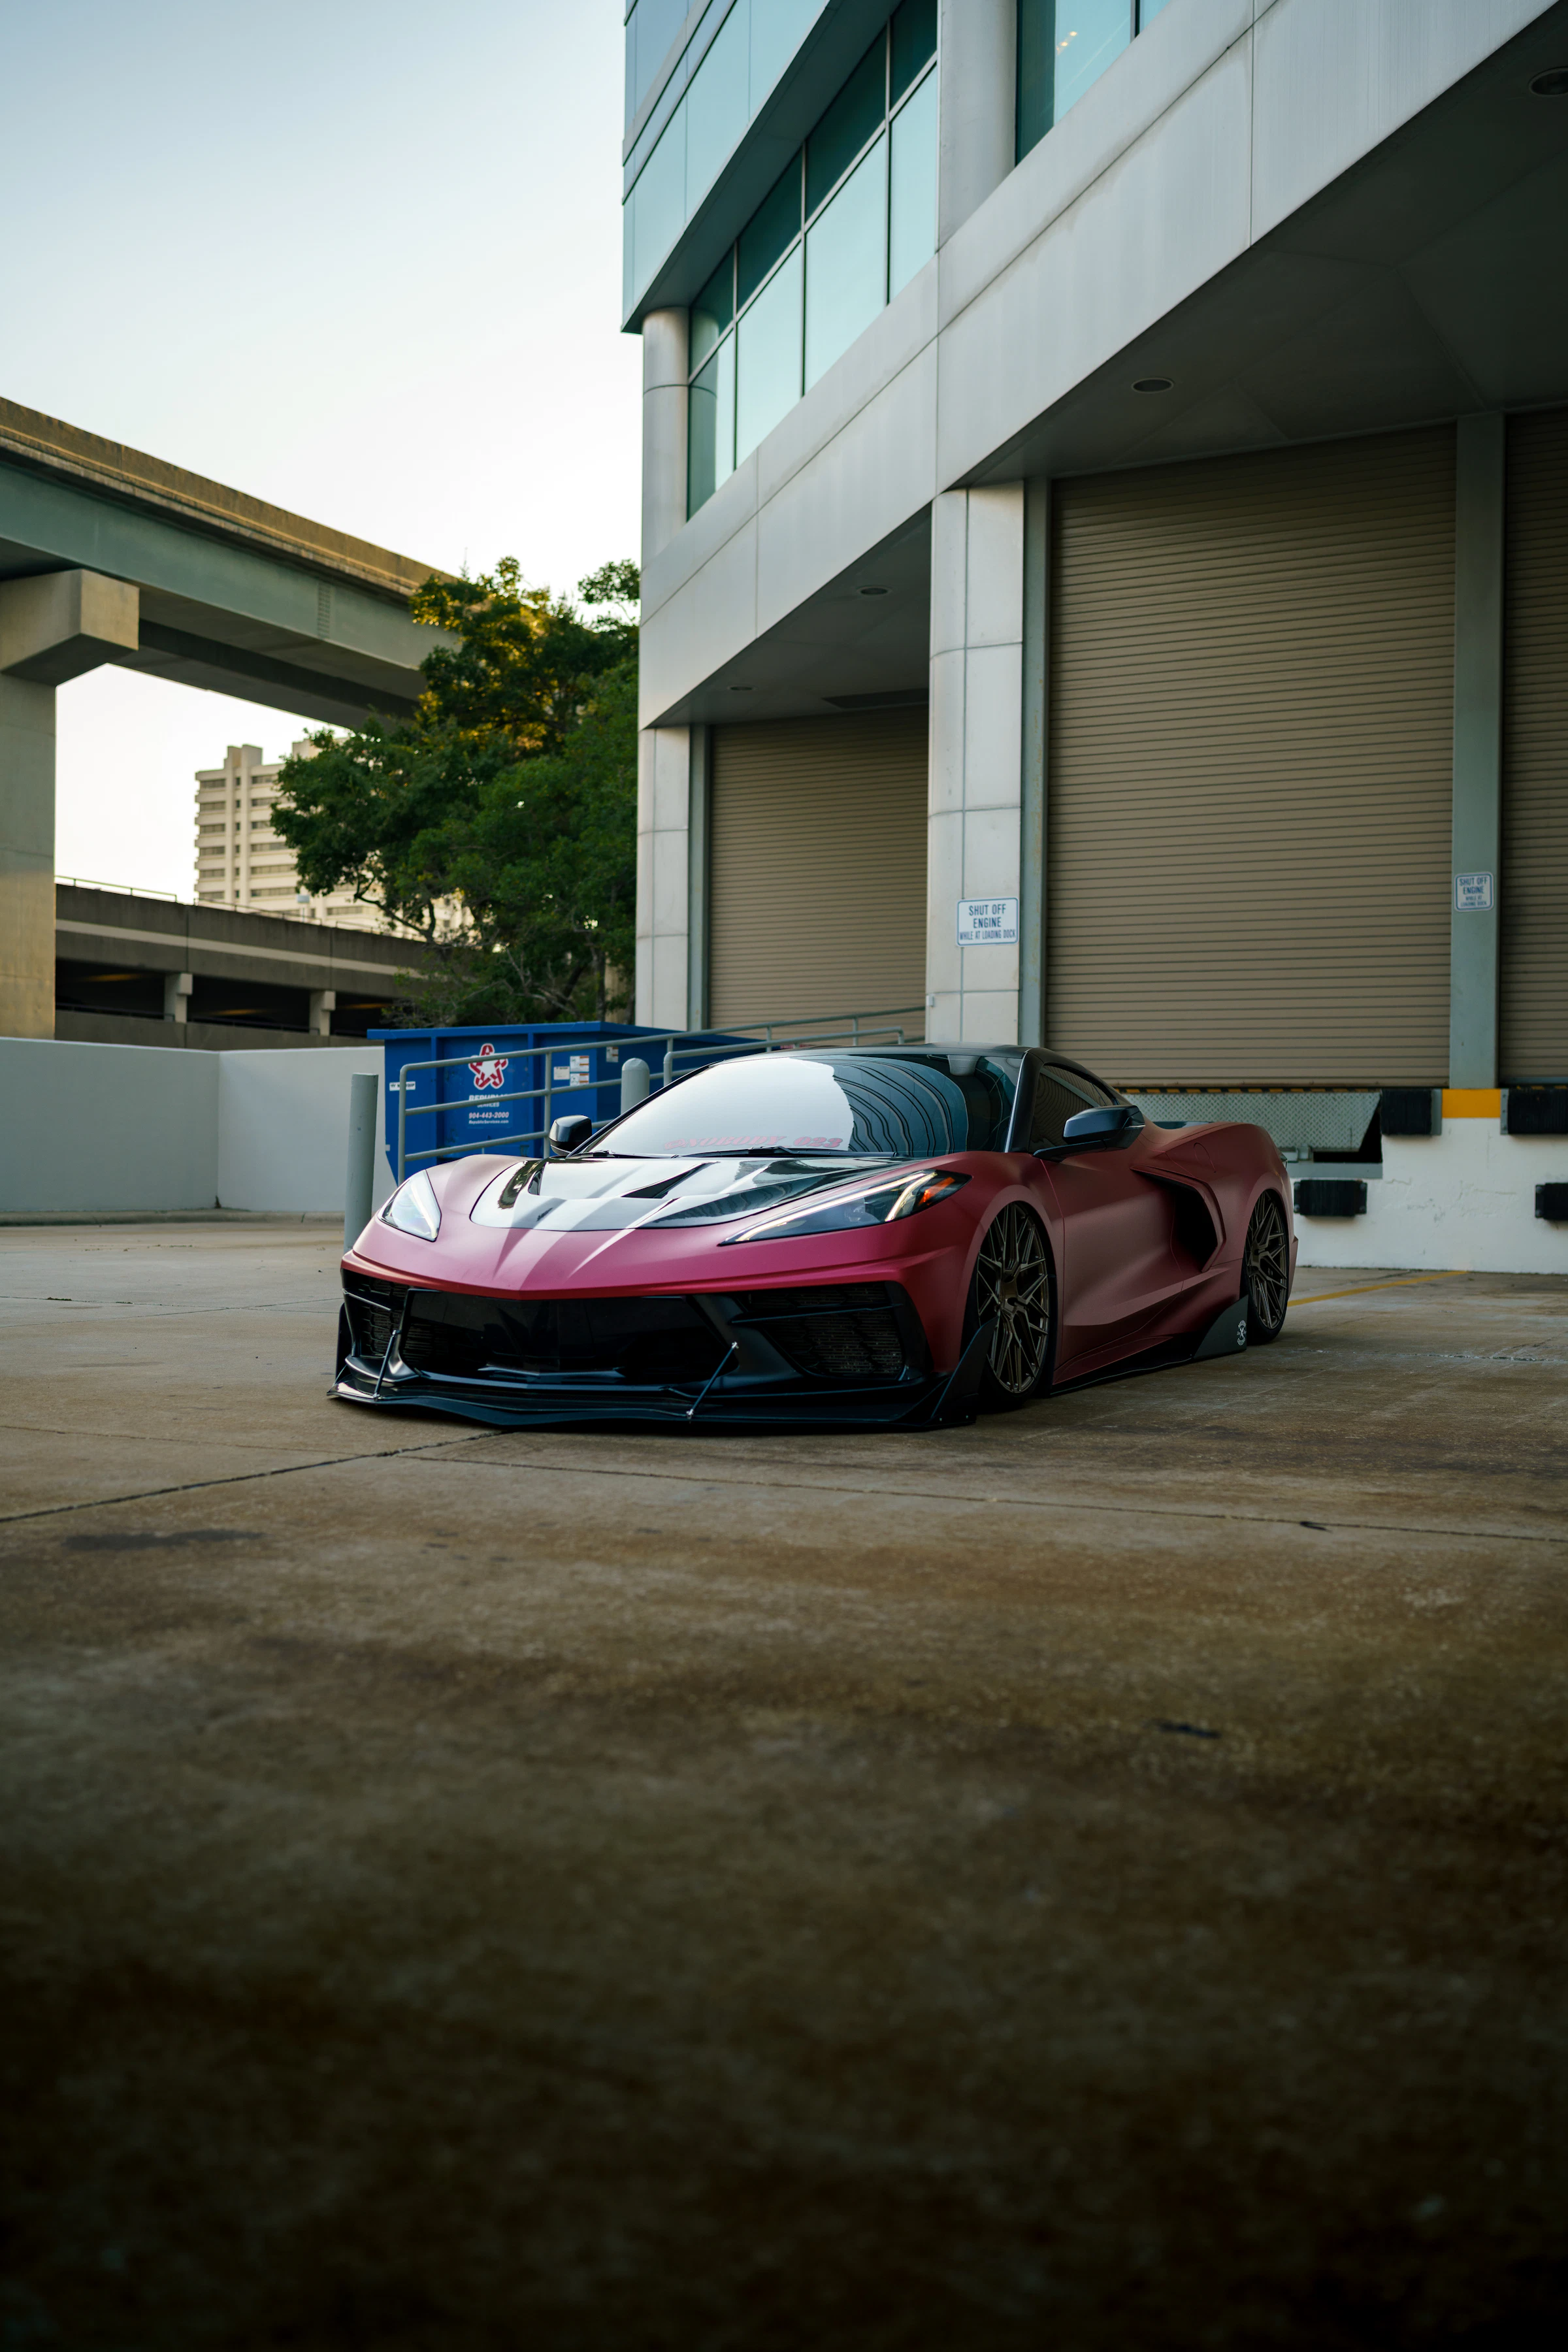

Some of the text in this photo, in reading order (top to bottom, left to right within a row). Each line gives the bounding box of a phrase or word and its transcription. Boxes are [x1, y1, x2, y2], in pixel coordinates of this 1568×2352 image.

[1459, 877, 1475, 887] SHUT
[1463, 886, 1484, 894] ENGINE
[968, 904, 1006, 916] SHUT OFF
[973, 917, 1002, 928] ENGINE
[960, 929, 1016, 940] WHILE AT LOADING DOCK
